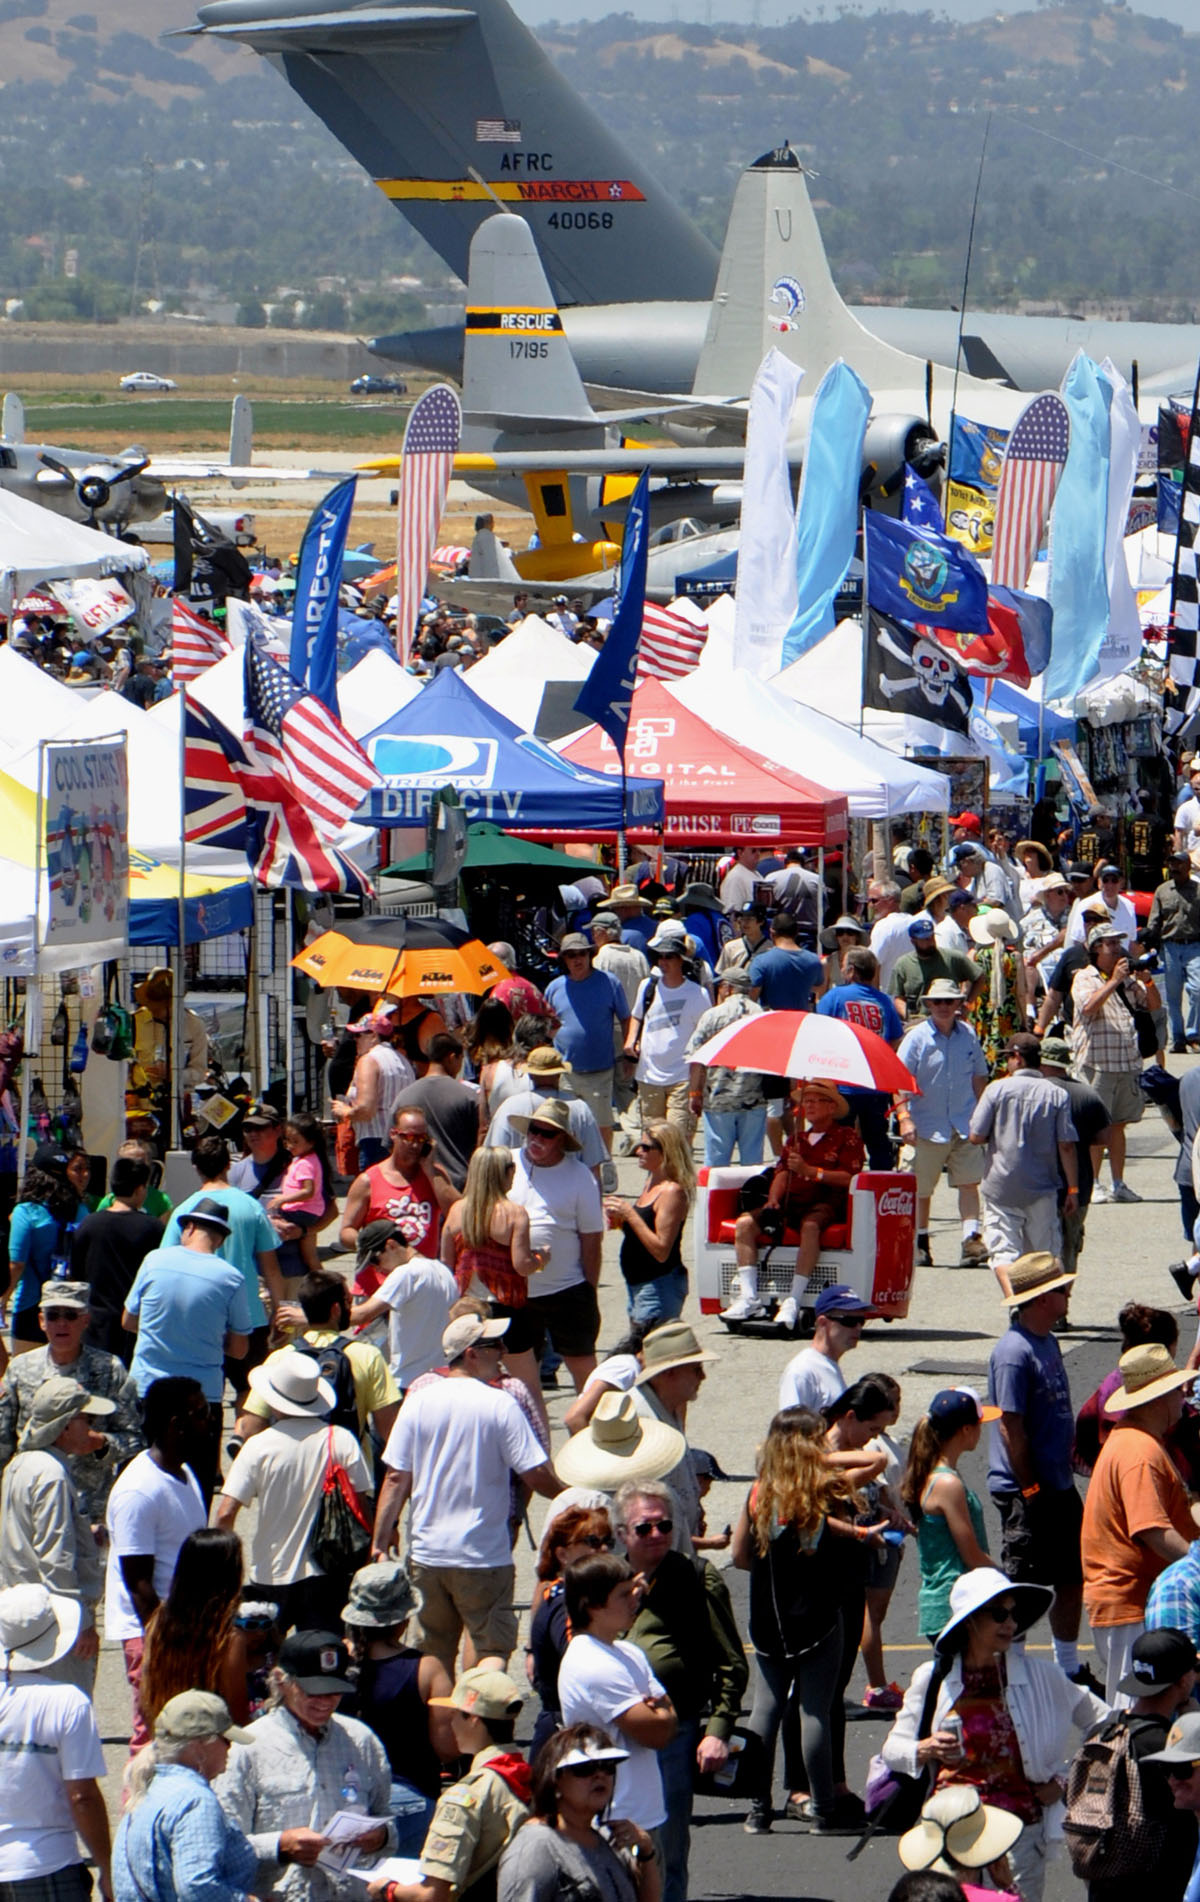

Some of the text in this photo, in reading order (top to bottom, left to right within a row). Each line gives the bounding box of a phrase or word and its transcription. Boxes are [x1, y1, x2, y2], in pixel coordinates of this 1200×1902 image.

[500, 152, 553, 171] AFRC
[516, 183, 599, 199] MARCH
[547, 212, 613, 230] 40068
[501, 313, 554, 330] RESCUE
[510, 341, 548, 359] 17195
[603, 762, 736, 776] DIGITAL
[382, 788, 525, 819] DIRCTV.
[351, 969, 385, 980] KTM
[421, 972, 453, 982] KTM
[844, 1001, 883, 1033] 88
